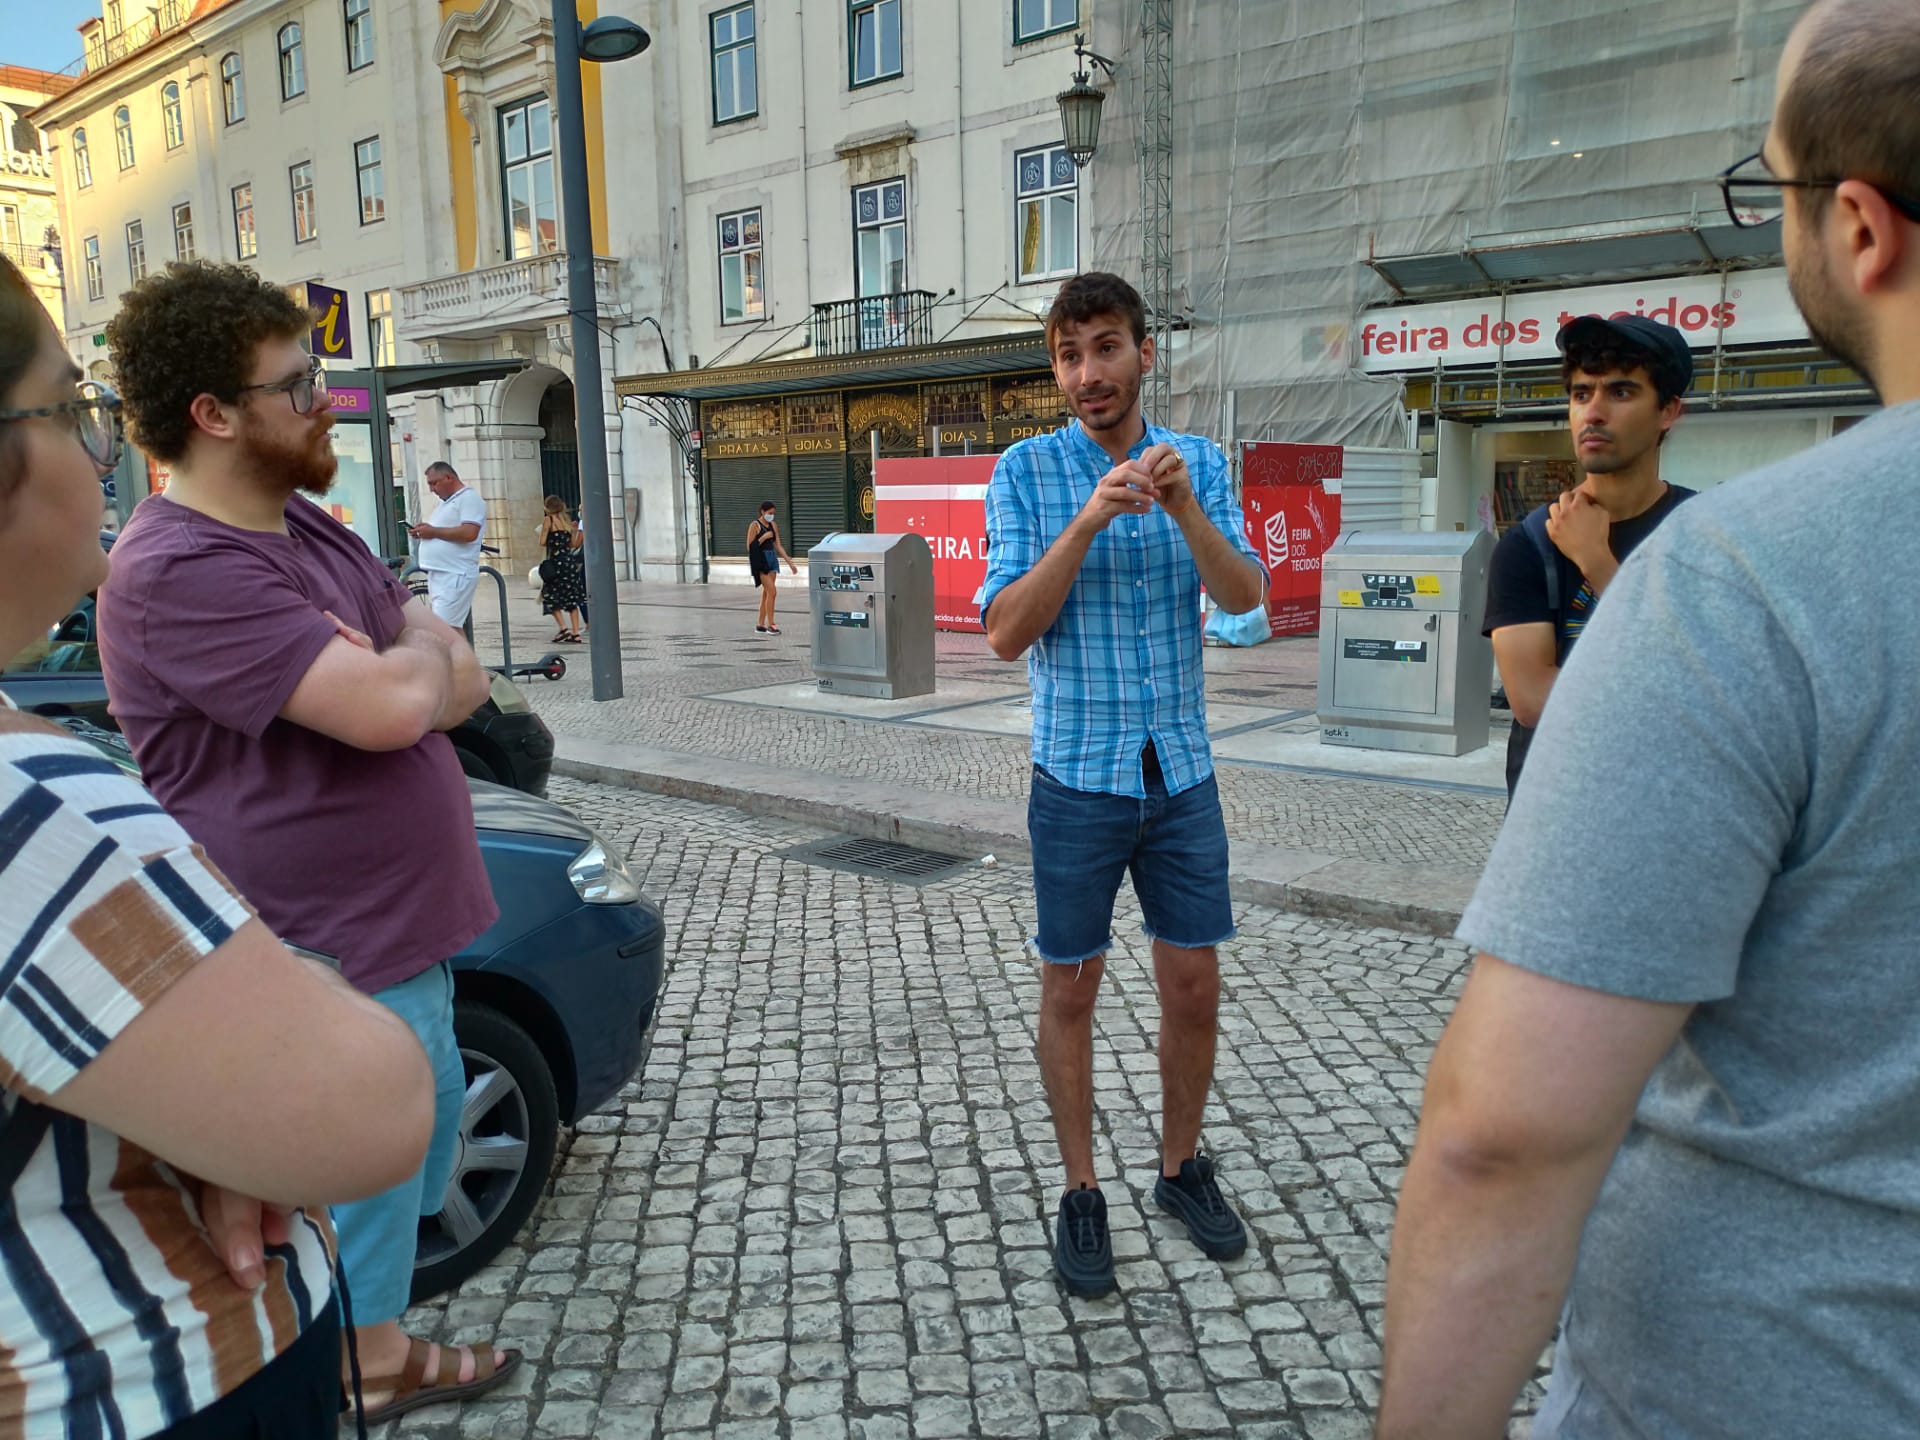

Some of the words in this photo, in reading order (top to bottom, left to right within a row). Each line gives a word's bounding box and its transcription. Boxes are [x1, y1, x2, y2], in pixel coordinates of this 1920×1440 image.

[1361, 320, 1449, 356] feira
[1462, 314, 1541, 349] dos
[858, 406, 908, 427] JOALHEIROS
[1011, 424, 1066, 439] PRAT
[719, 442, 769, 455] PRATAS
[795, 439, 832, 451] JOIAS
[1292, 528, 1312, 541] FEIRA
[1291, 544, 1306, 557] DOS
[1291, 557, 1320, 572] TECIDOS
[955, 615, 963, 623] de
